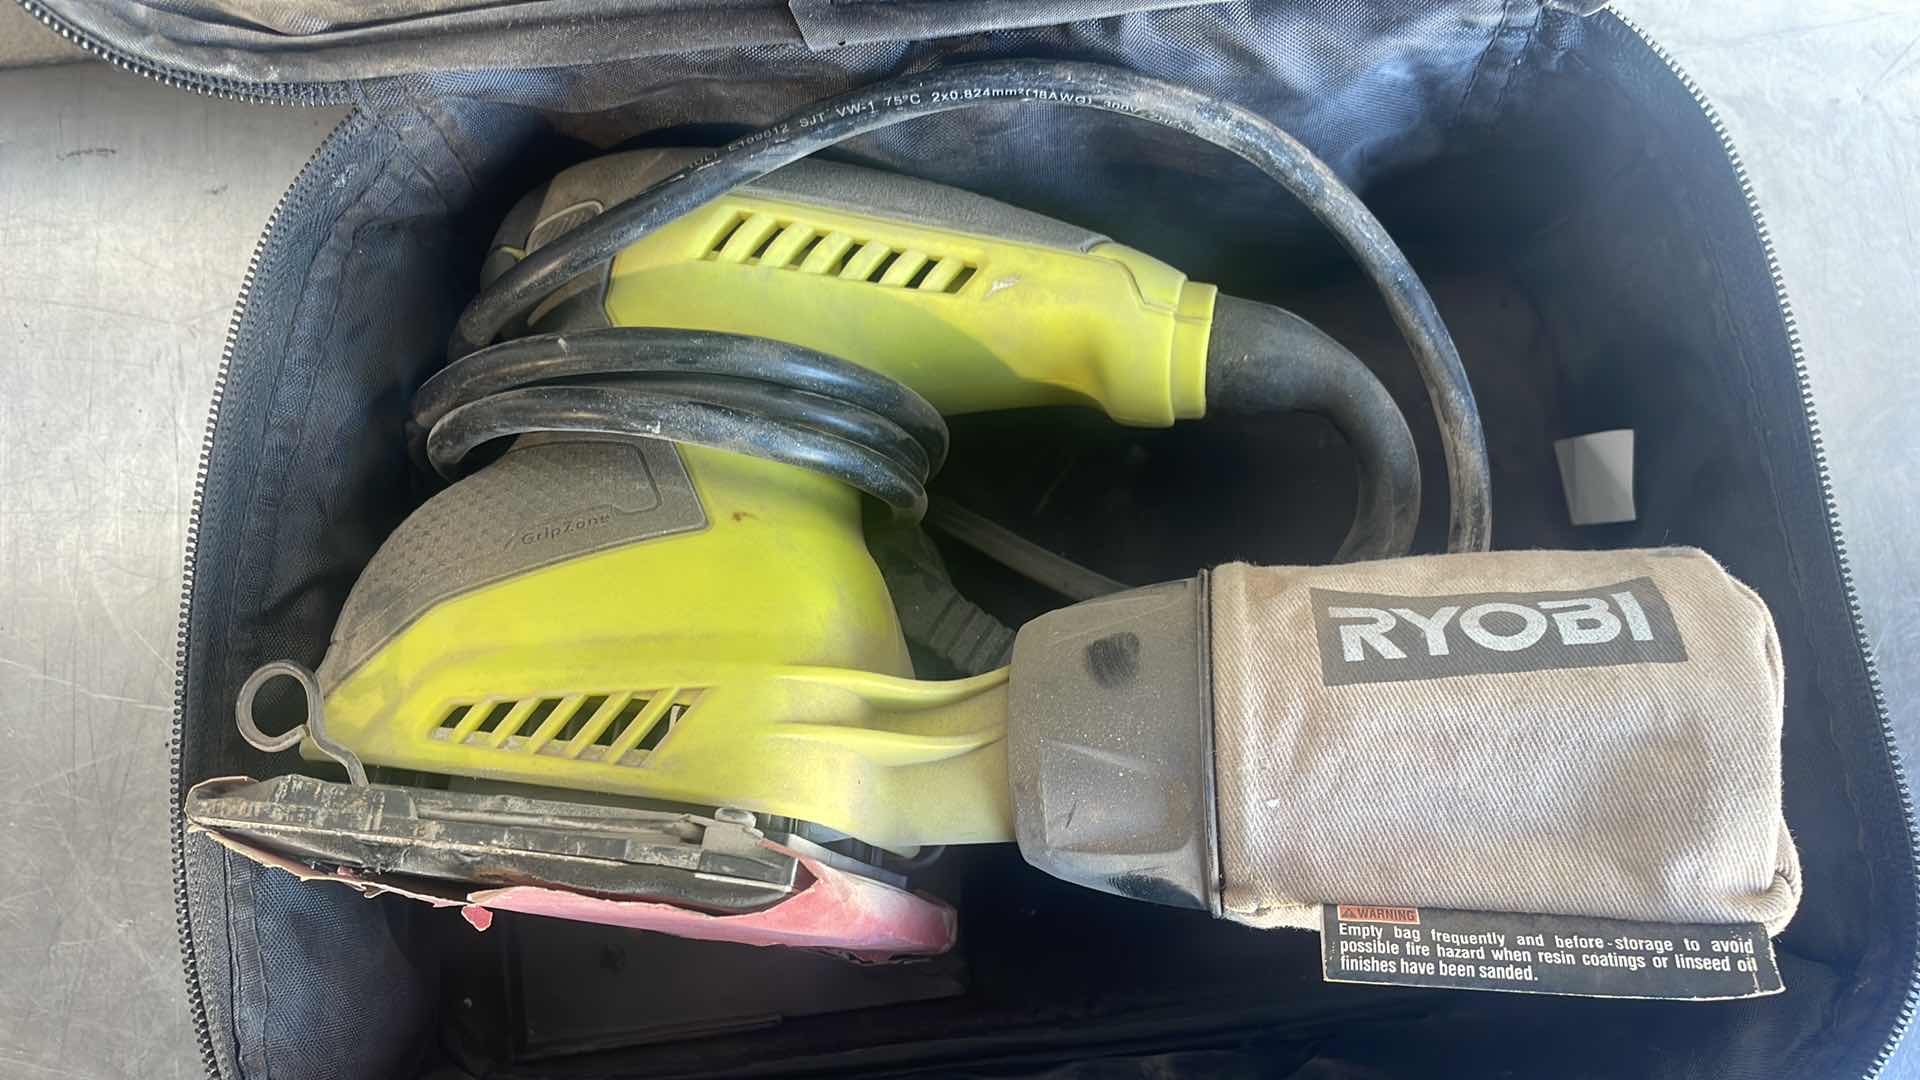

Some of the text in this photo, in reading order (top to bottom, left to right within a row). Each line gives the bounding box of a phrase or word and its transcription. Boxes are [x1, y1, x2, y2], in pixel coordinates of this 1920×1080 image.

[799, 110, 827, 129] SJT
[835, 98, 876, 119] VW-1
[520, 512, 610, 545] GripZone
[1328, 591, 1655, 662] RYOBI
[1357, 908, 1416, 922] WARNING
[1338, 923, 1383, 941] Empty
[1394, 927, 1421, 942] bag
[1431, 929, 1505, 947] frequently
[1516, 934, 1545, 948] and
[1684, 938, 1700, 952] to
[1711, 938, 1754, 955] avoid
[1340, 940, 1758, 973] possible fire hazard when resin coatings or linseed oil
[1340, 954, 1539, 982] finishes have been sanded.
